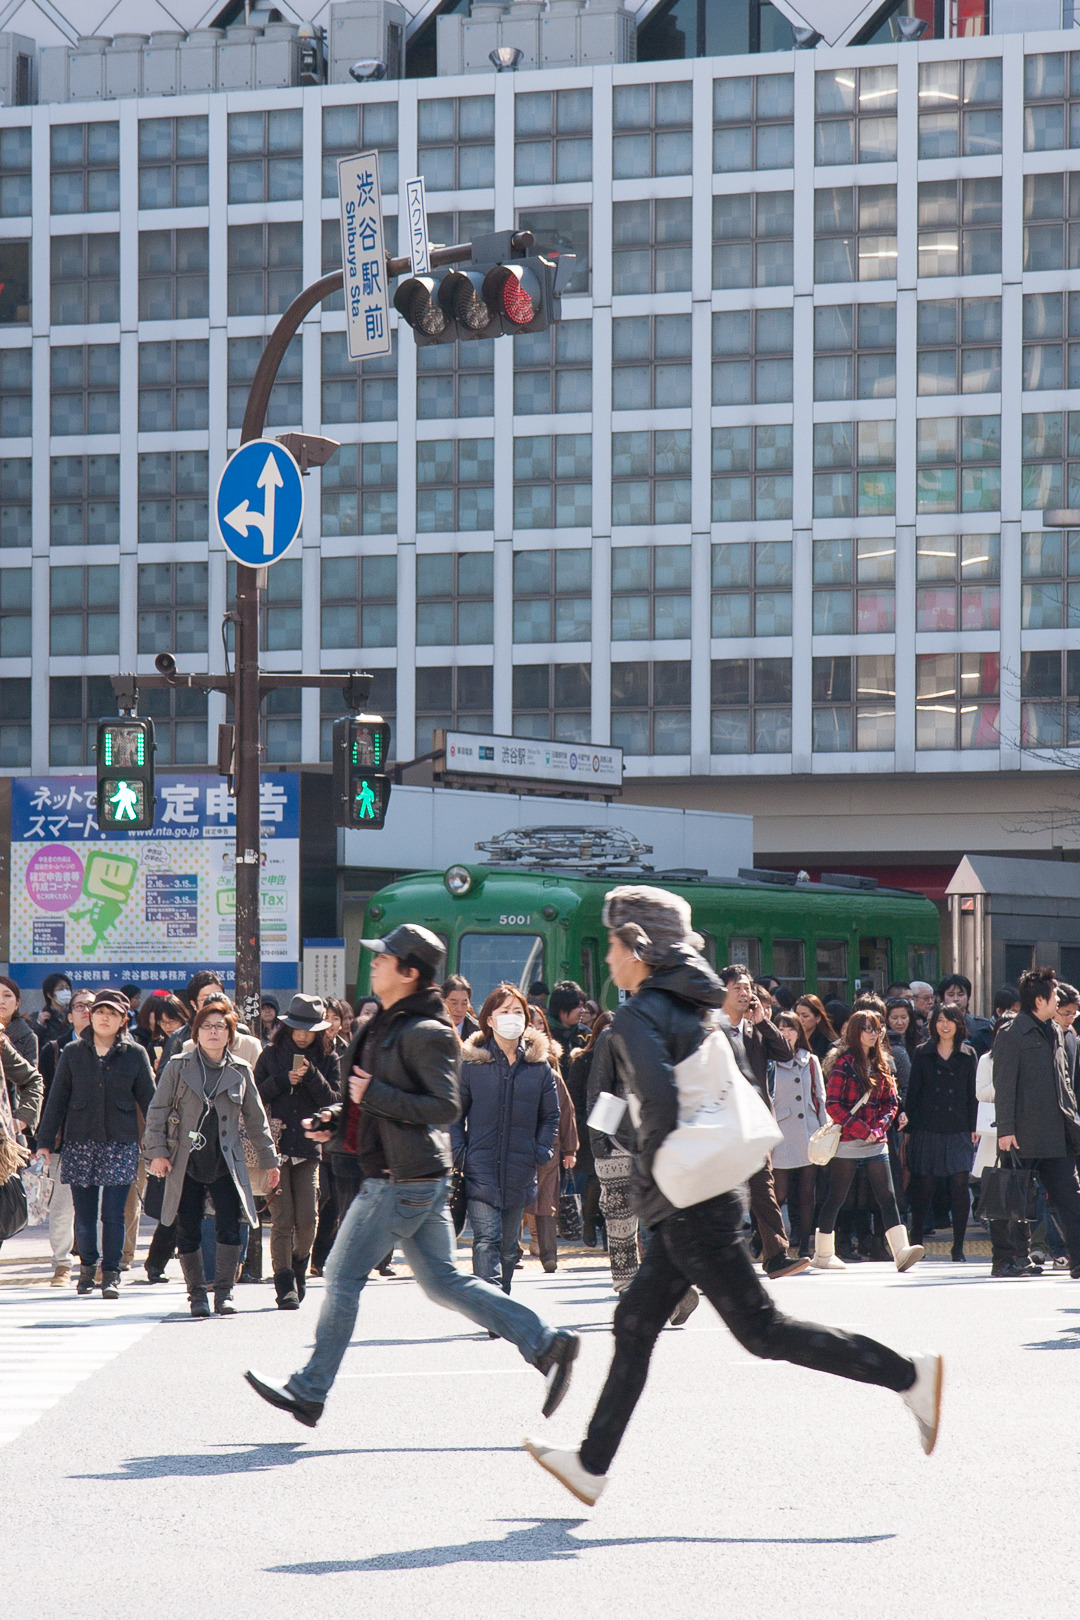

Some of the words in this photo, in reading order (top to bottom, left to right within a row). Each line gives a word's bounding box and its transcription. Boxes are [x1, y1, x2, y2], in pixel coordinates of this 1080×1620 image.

[345, 201, 358, 278] Shibuya
[356, 170, 384, 341] 渋谷駅前
[350, 287, 361, 324] Sta.
[501, 746, 526, 765] 渋谷駅
[128, 826, 199, 837] www.nta.go.jp
[499, 915, 531, 925] 5001
